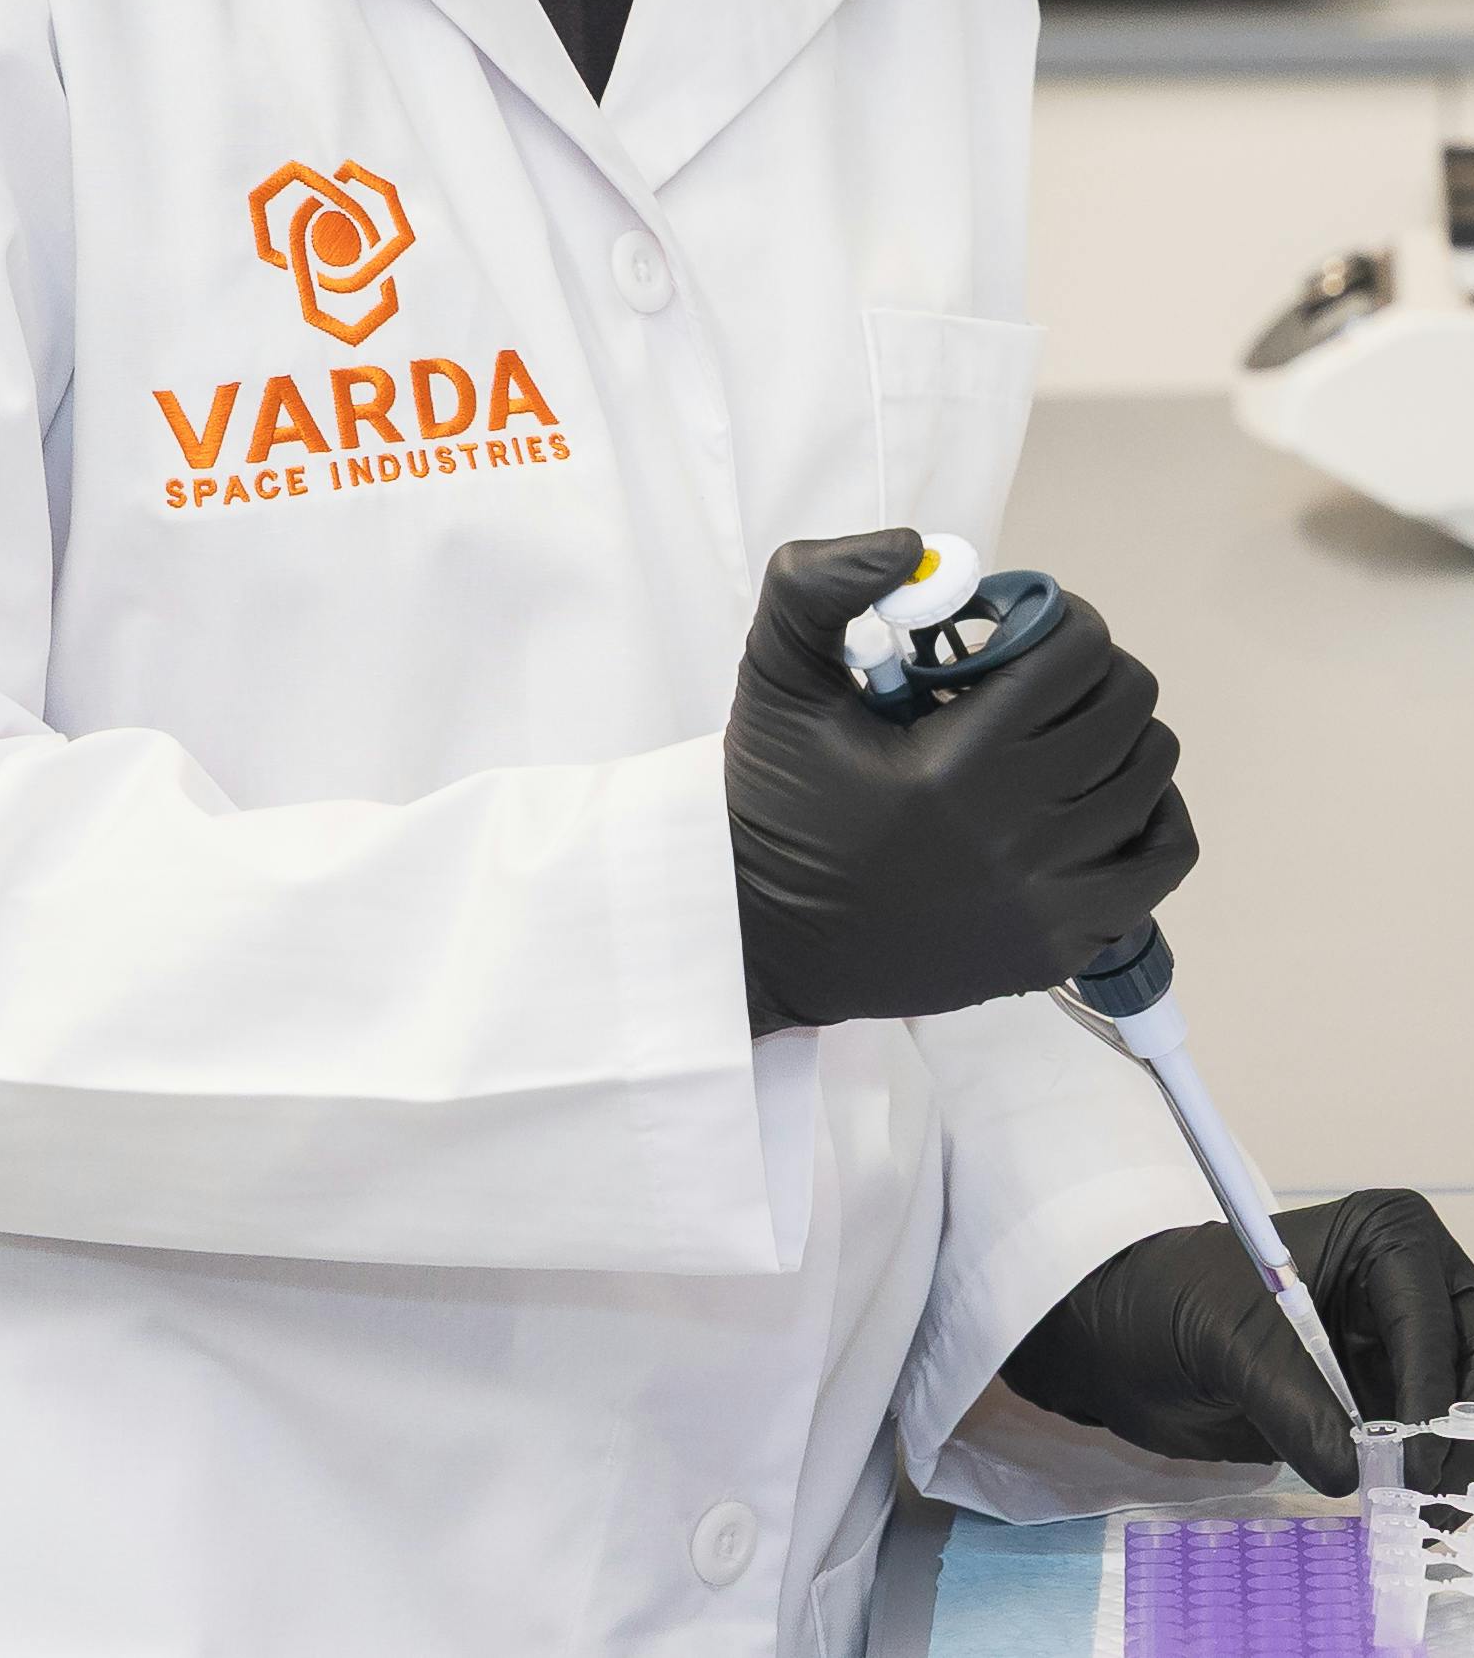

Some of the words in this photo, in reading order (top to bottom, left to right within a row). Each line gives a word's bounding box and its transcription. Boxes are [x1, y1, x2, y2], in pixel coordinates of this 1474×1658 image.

[153, 349, 559, 470] VARDA
[166, 465, 308, 510] SPACE
[330, 432, 572, 491] INDUSTRIES
